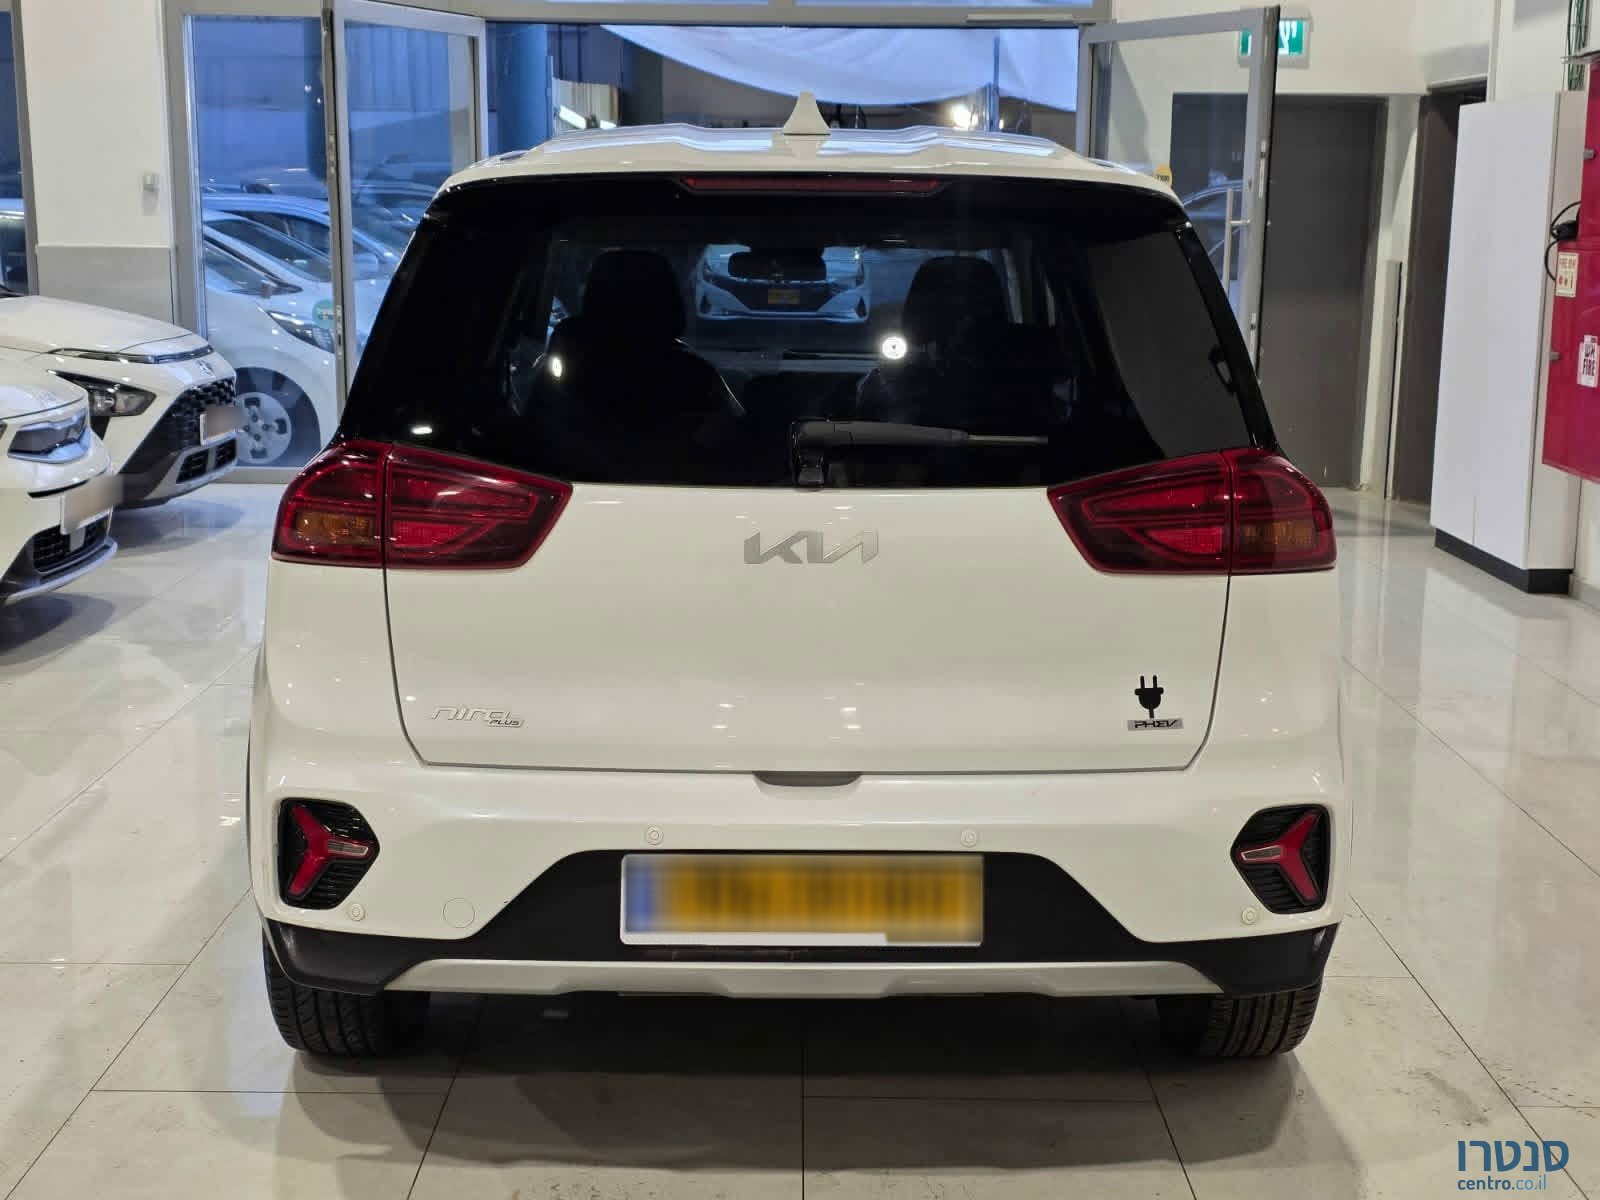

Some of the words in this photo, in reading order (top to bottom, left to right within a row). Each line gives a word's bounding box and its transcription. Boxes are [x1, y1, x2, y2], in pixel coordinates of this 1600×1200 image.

[1582, 359, 1596, 376] FIRE
[744, 530, 880, 564] KIA
[1134, 719, 1178, 728] PHEV
